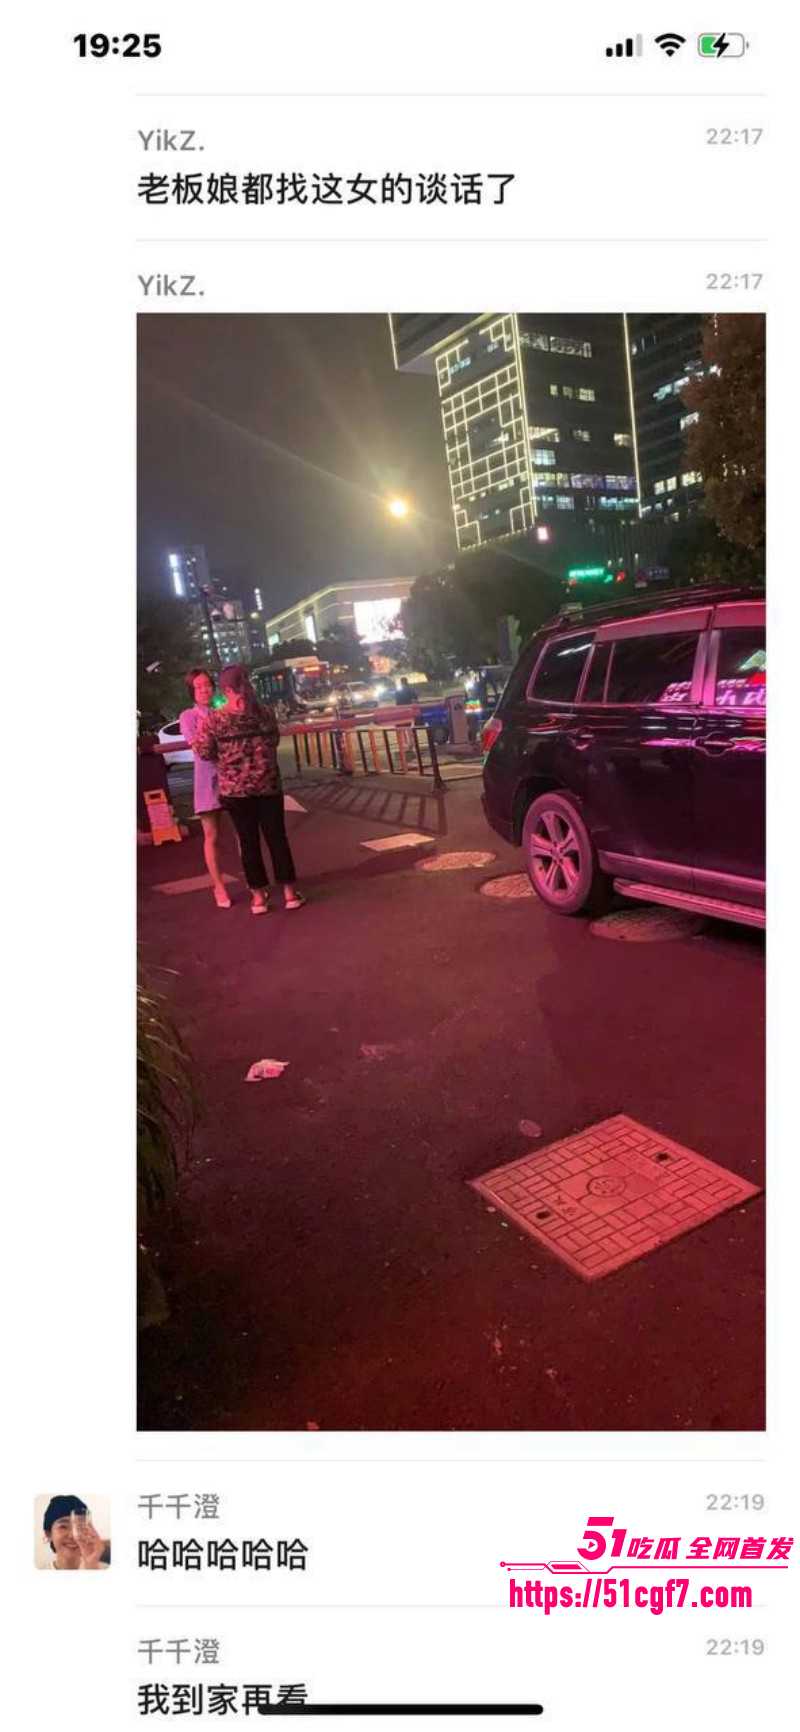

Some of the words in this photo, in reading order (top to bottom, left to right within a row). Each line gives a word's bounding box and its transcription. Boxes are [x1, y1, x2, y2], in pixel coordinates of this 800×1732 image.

[73, 33, 162, 58] 19:25
[138, 129, 204, 151] YikZ.
[706, 128, 763, 144] 22:17
[138, 172, 515, 205] 老板娘都找这女的谈话了
[138, 274, 204, 296] YikZ.
[706, 273, 763, 289] 22:17
[138, 1494, 219, 1520] 千千澄
[707, 1494, 764, 1510] 22:19
[138, 1538, 309, 1571] 哈哈哈哈哈
[138, 1639, 219, 1665] 千千澄
[707, 1639, 764, 1655] 22:19
